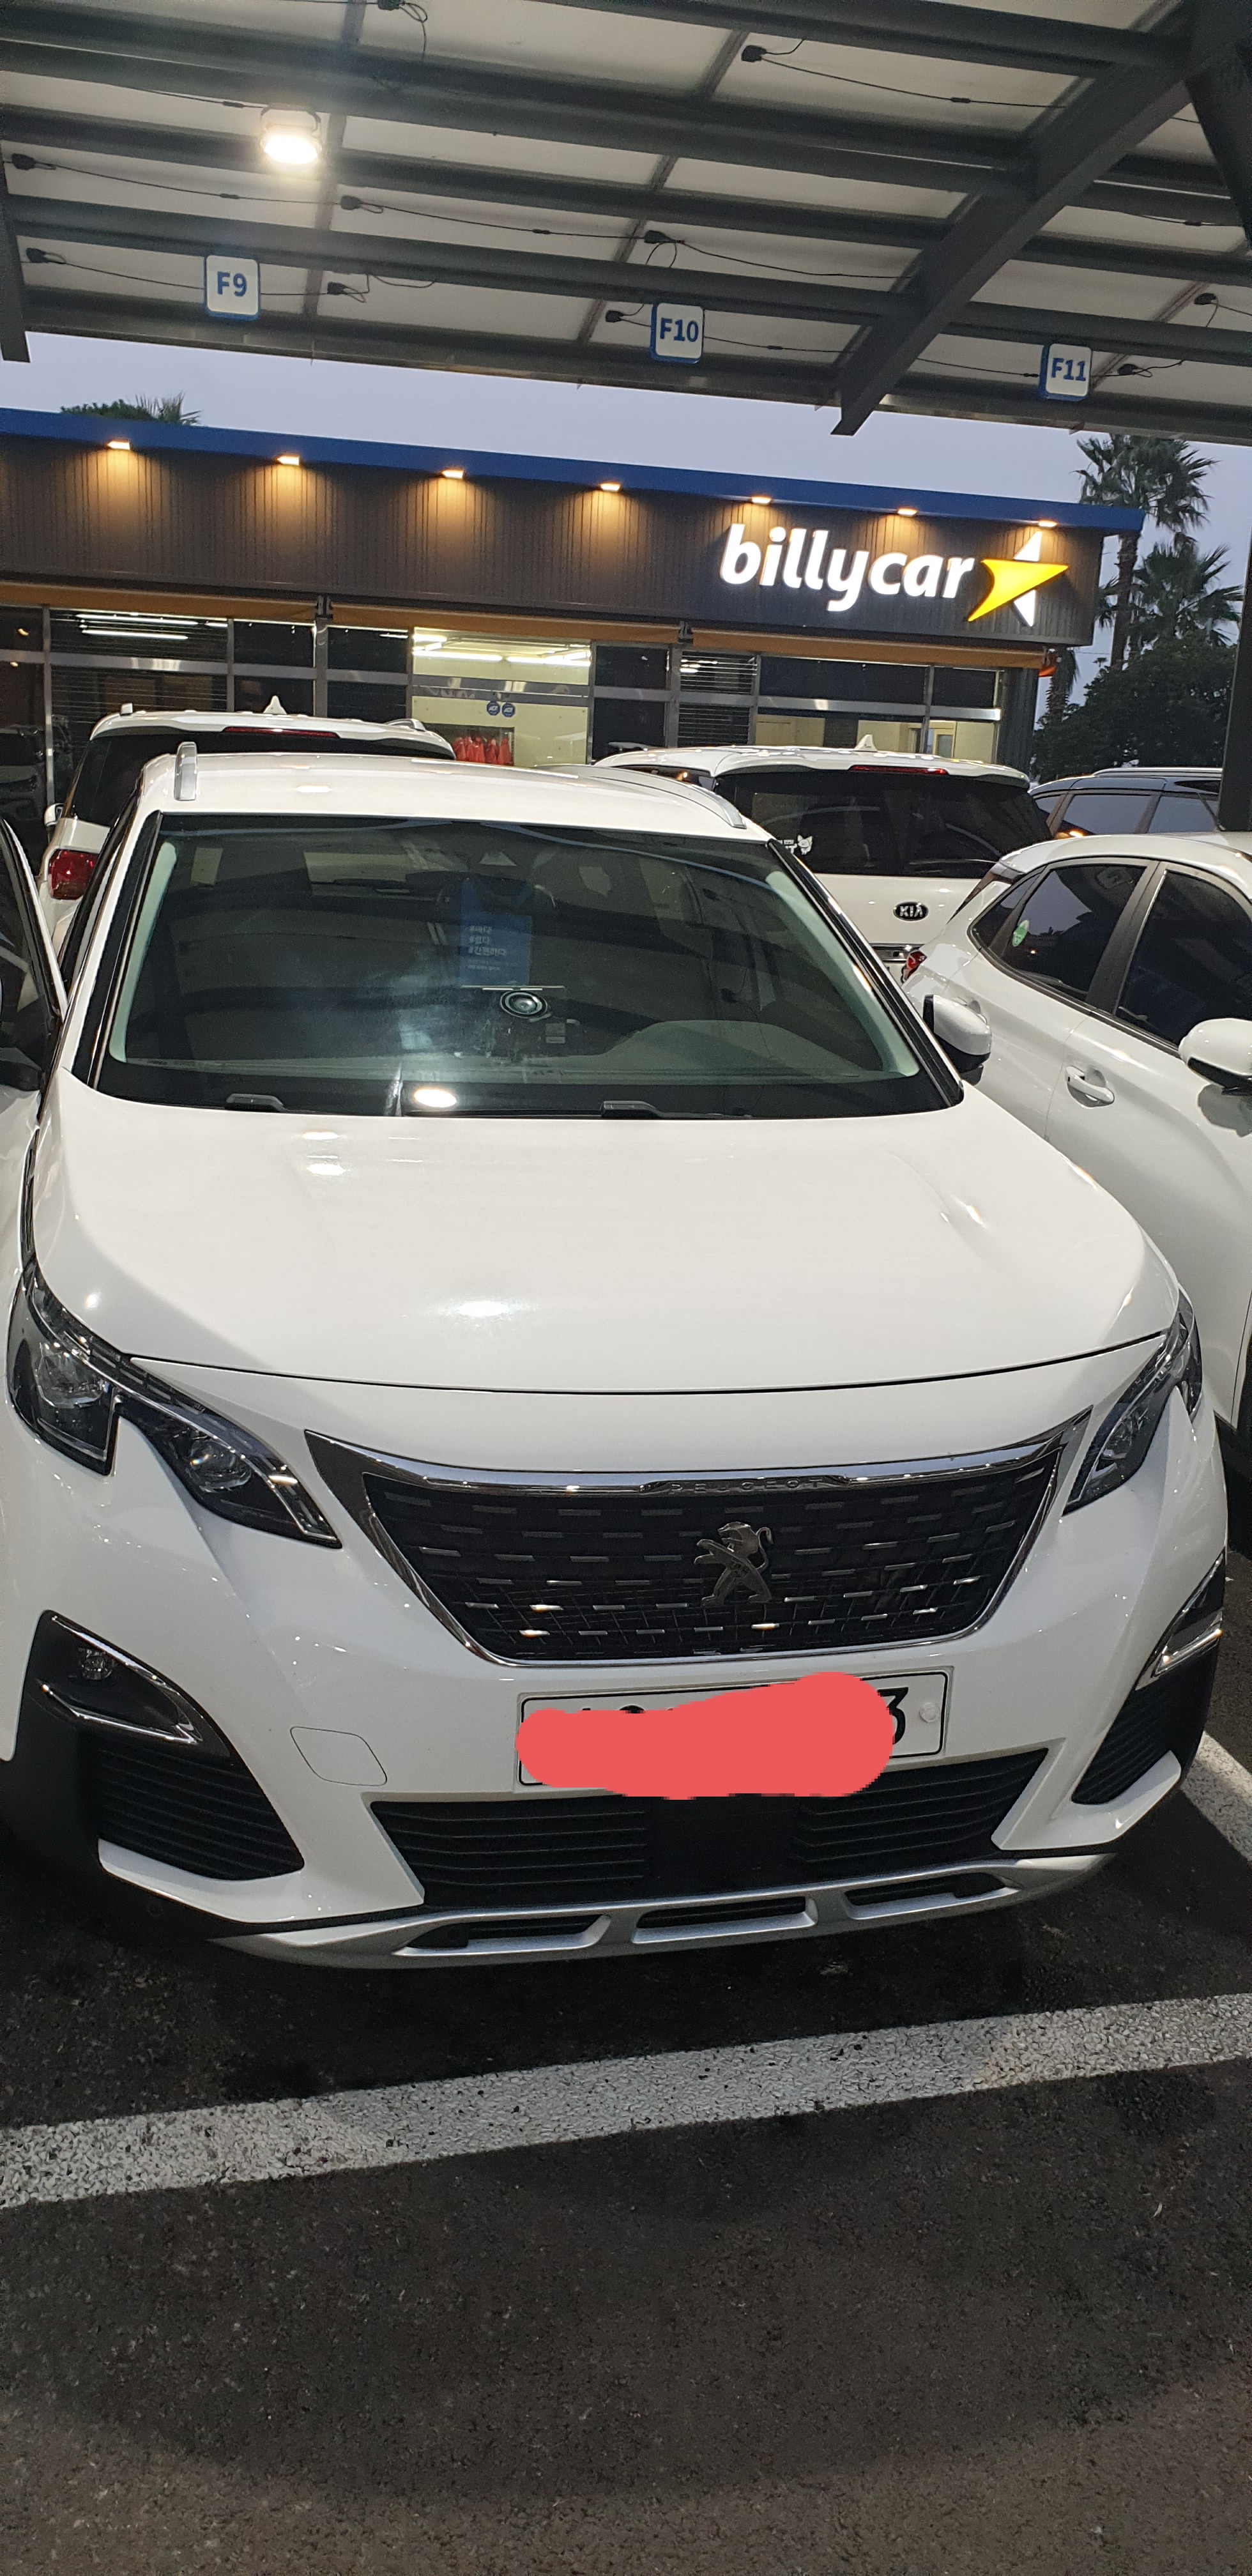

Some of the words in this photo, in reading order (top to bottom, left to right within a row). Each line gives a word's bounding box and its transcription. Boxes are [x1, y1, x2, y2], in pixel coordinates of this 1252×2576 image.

[216, 271, 248, 298] F9
[659, 317, 699, 343] F10
[1051, 358, 1087, 383] F11
[721, 523, 975, 612] billycar
[899, 904, 924, 918] KIA
